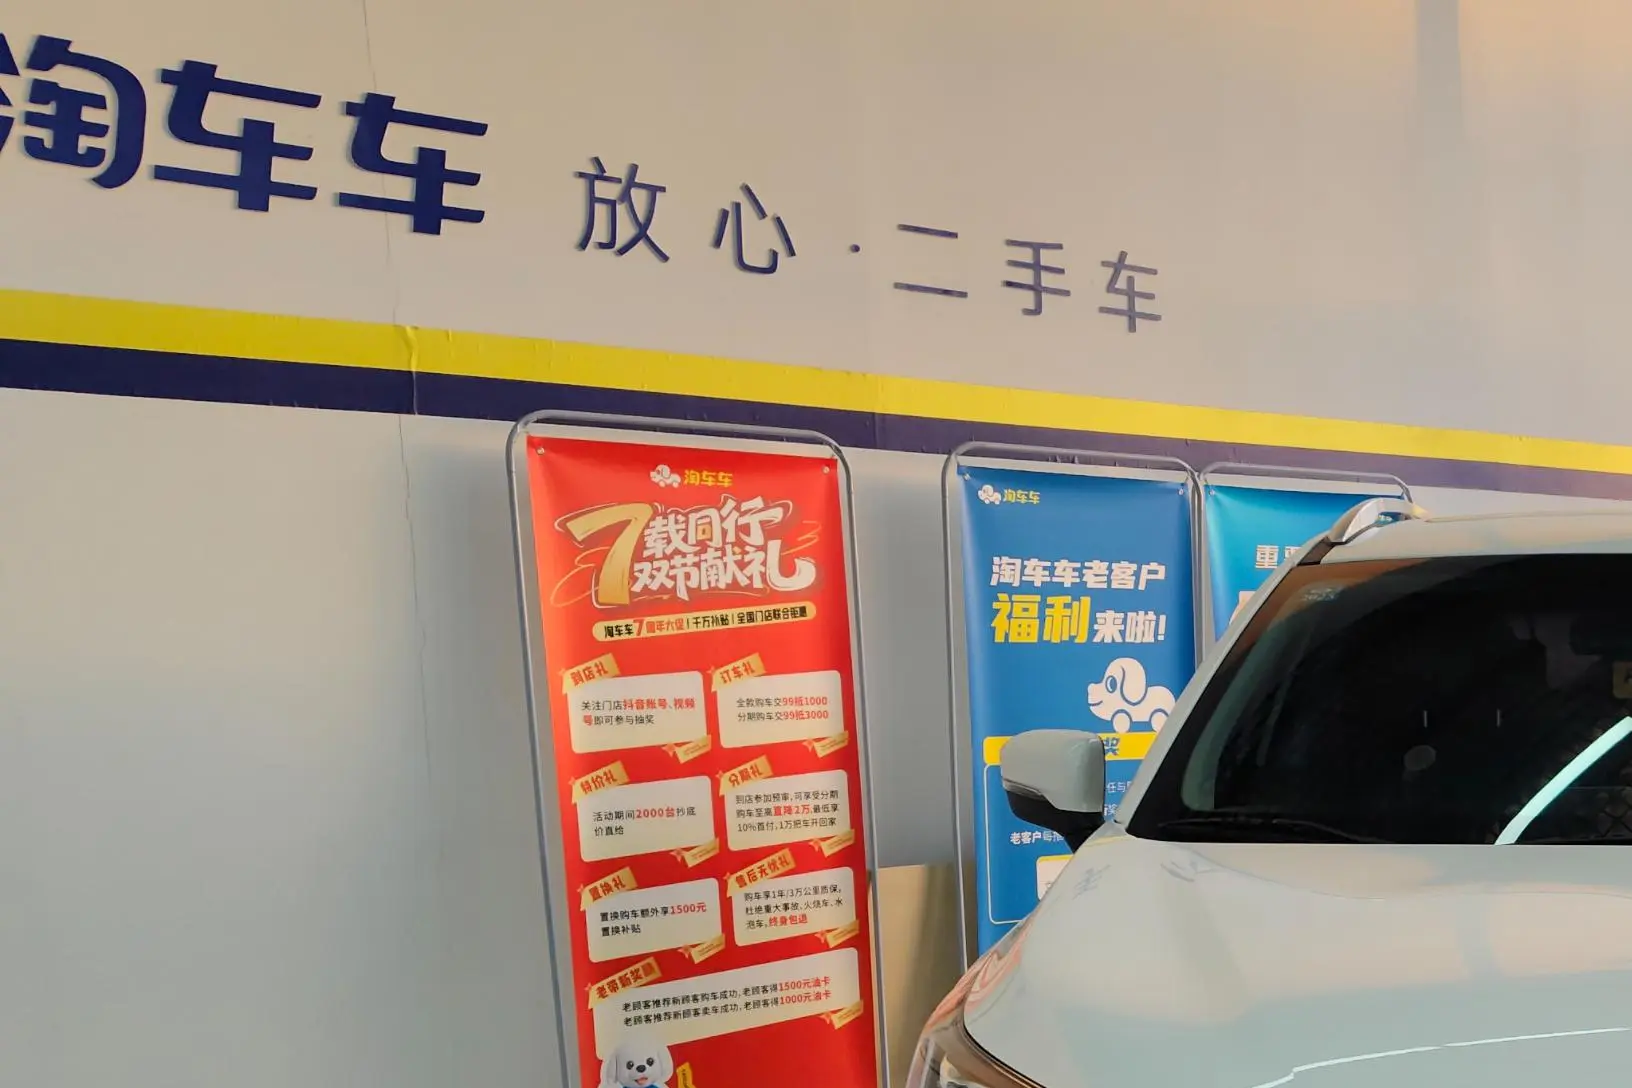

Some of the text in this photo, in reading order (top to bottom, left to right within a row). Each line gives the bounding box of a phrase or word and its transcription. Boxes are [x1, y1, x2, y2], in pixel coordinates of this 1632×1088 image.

[0, 33, 488, 236] 淘车车
[684, 470, 733, 487] 淘车车
[1003, 488, 1041, 505] 淘车车
[631, 540, 816, 601] 双节献礼
[989, 556, 1167, 591] 淘车车老客户
[570, 661, 609, 686] 到店礼
[720, 661, 755, 684] 订车礼
[583, 714, 656, 726] 号即可参与抽奖
[580, 769, 618, 794] 特价礼
[593, 806, 696, 822] 活动期间2000台抄底
[594, 825, 624, 837] 价直给
[589, 875, 626, 901] 置换礼
[600, 902, 707, 922] 置换购车额外享1500元
[601, 924, 642, 937] 置换补贴
